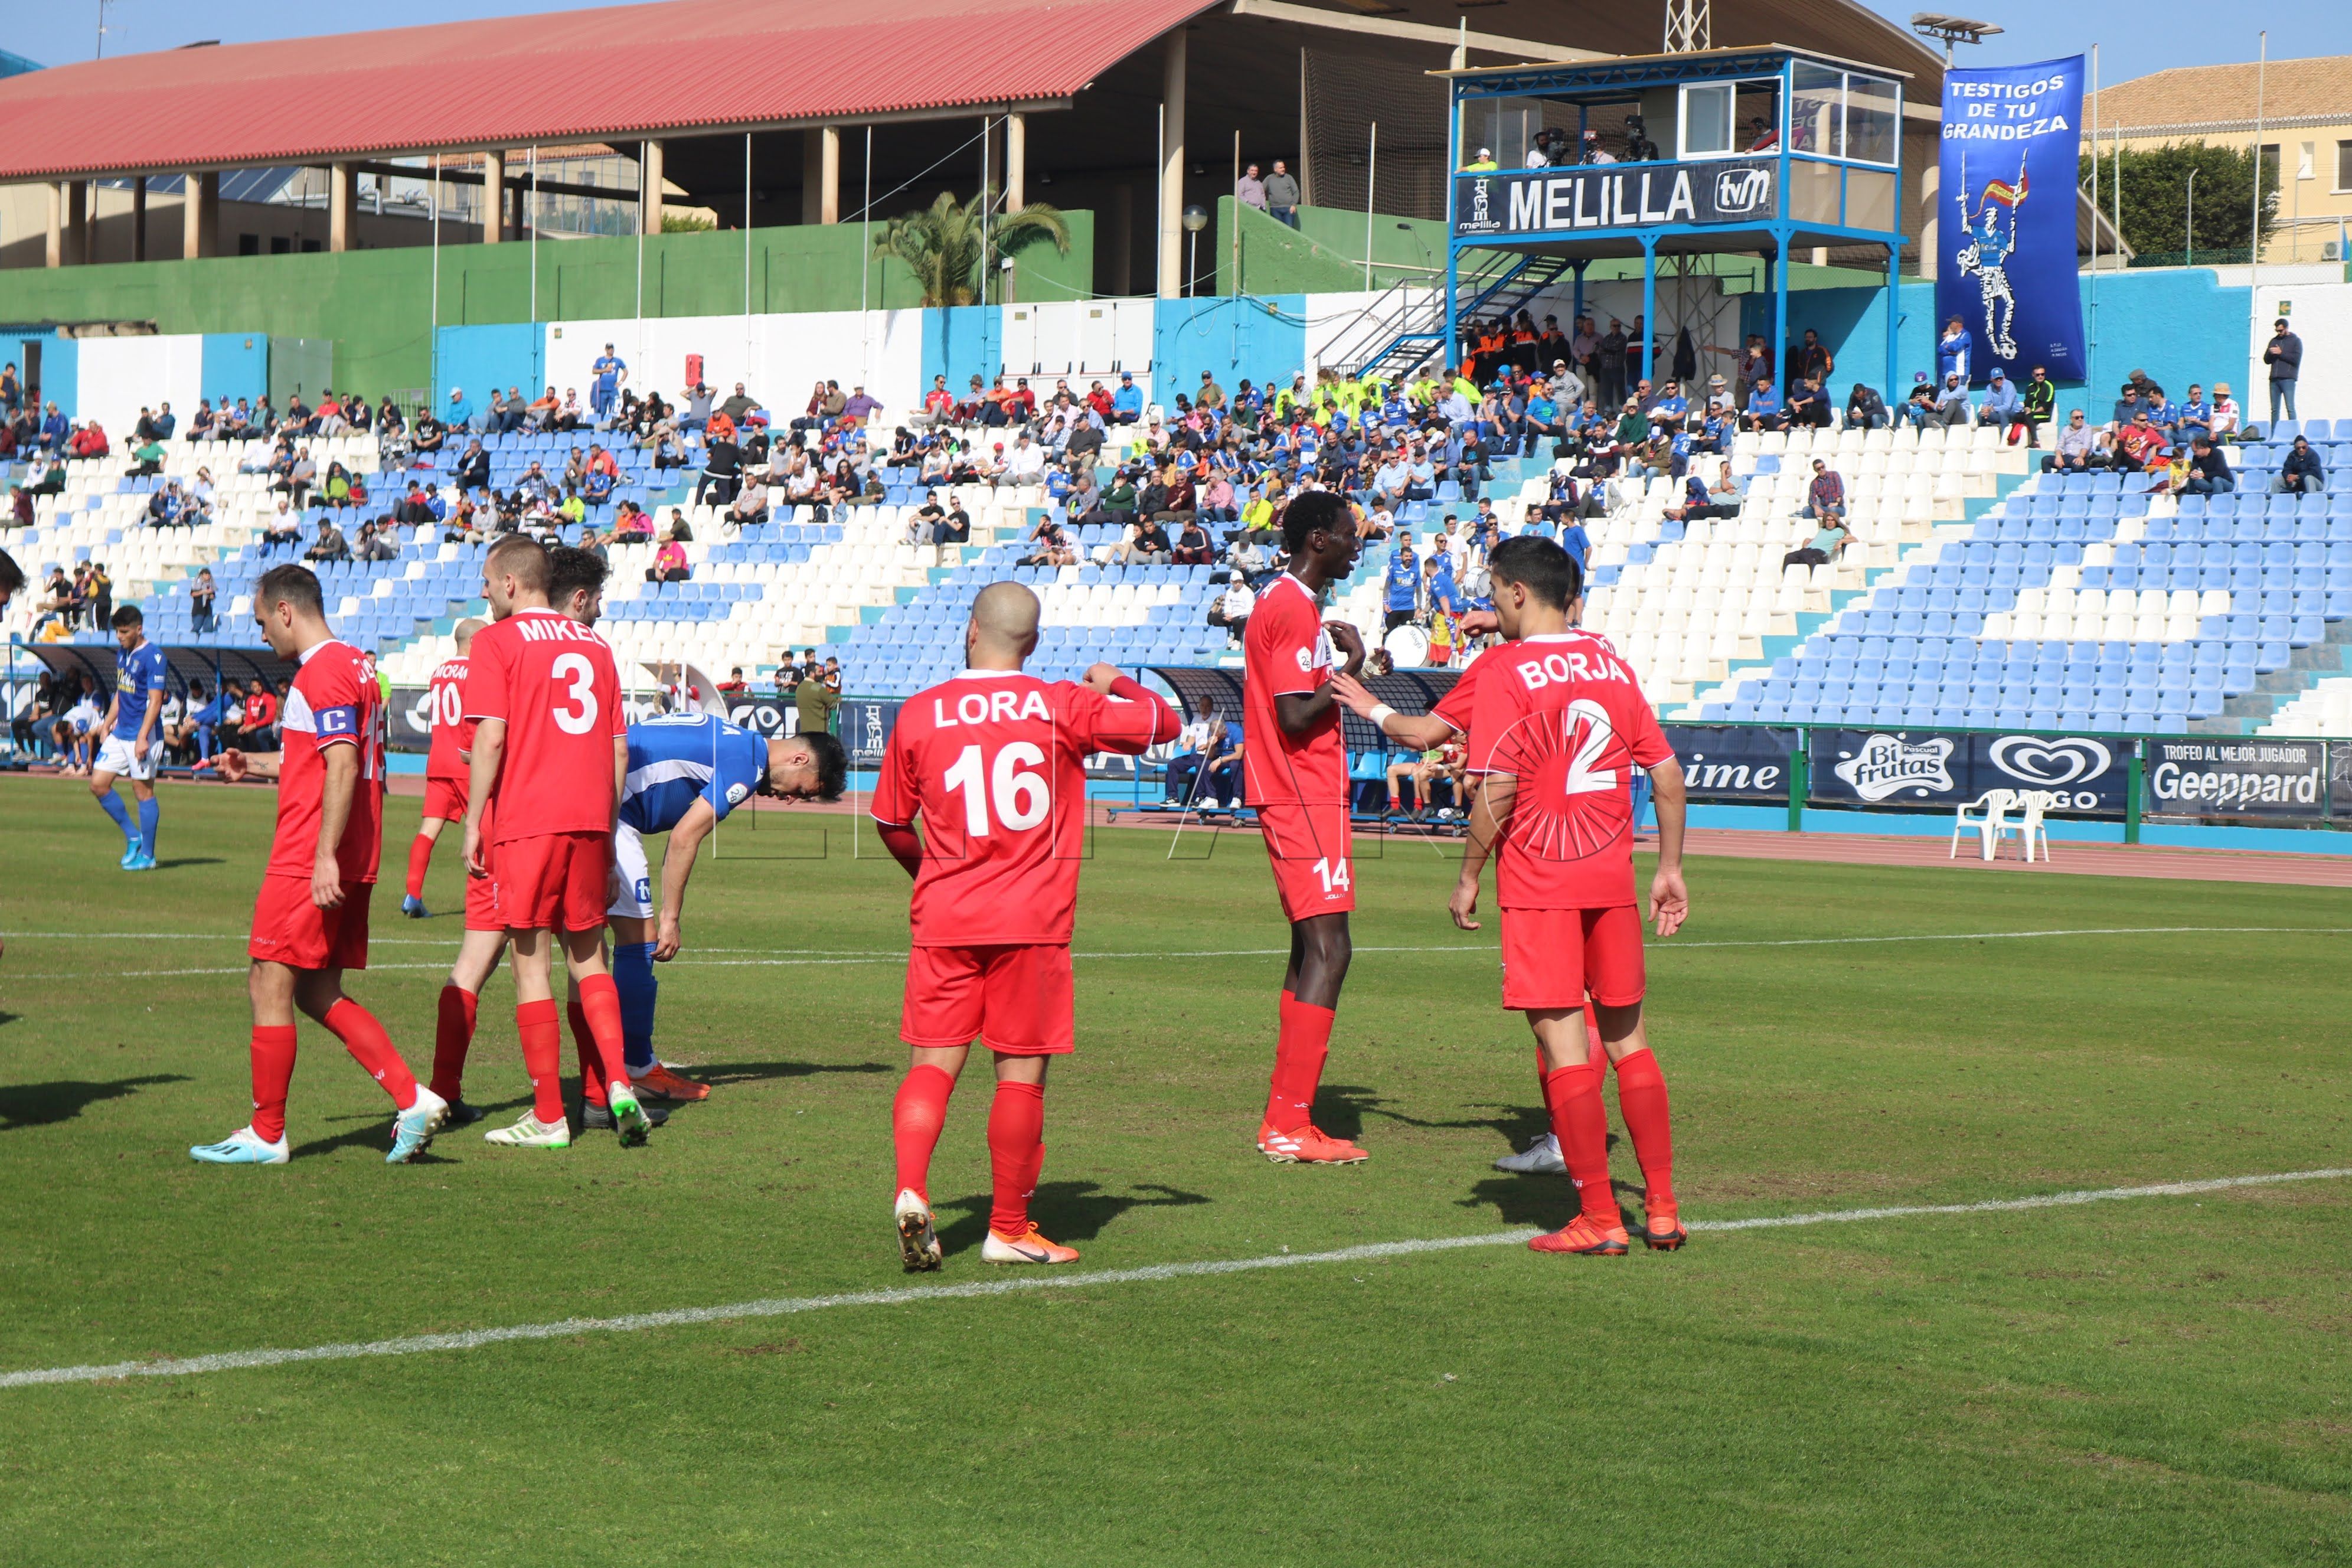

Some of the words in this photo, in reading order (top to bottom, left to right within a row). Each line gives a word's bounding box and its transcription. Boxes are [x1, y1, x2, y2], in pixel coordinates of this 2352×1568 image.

[1951, 75, 2064, 99] TESTIGOS
[1968, 103, 1997, 117] DE
[2005, 102, 2036, 119] TU
[1943, 115, 2069, 141] GRANDEZA
[1509, 169, 1696, 231] MELILLA
[1459, 220, 1501, 230] melilla
[516, 619, 607, 649] MIKEL
[1517, 652, 1631, 690] BORJA
[431, 682, 462, 727] 10
[551, 652, 598, 734] 3
[322, 710, 346, 732] C
[935, 690, 1050, 729] LORA
[1565, 698, 1617, 795] 2
[1870, 743, 1898, 766] Bi
[1903, 745, 1938, 754] Pascual
[2162, 745, 2203, 761] TROFEO
[2205, 746, 2219, 761] AL
[2221, 746, 2256, 762] MEJOR
[2259, 747, 2307, 763] JUGADOR
[1680, 753, 1780, 790] ime
[1854, 759, 1941, 786] frutas
[2154, 762, 2319, 811] Geeppard
[944, 741, 1050, 837] 16
[1313, 857, 1350, 892] 14
